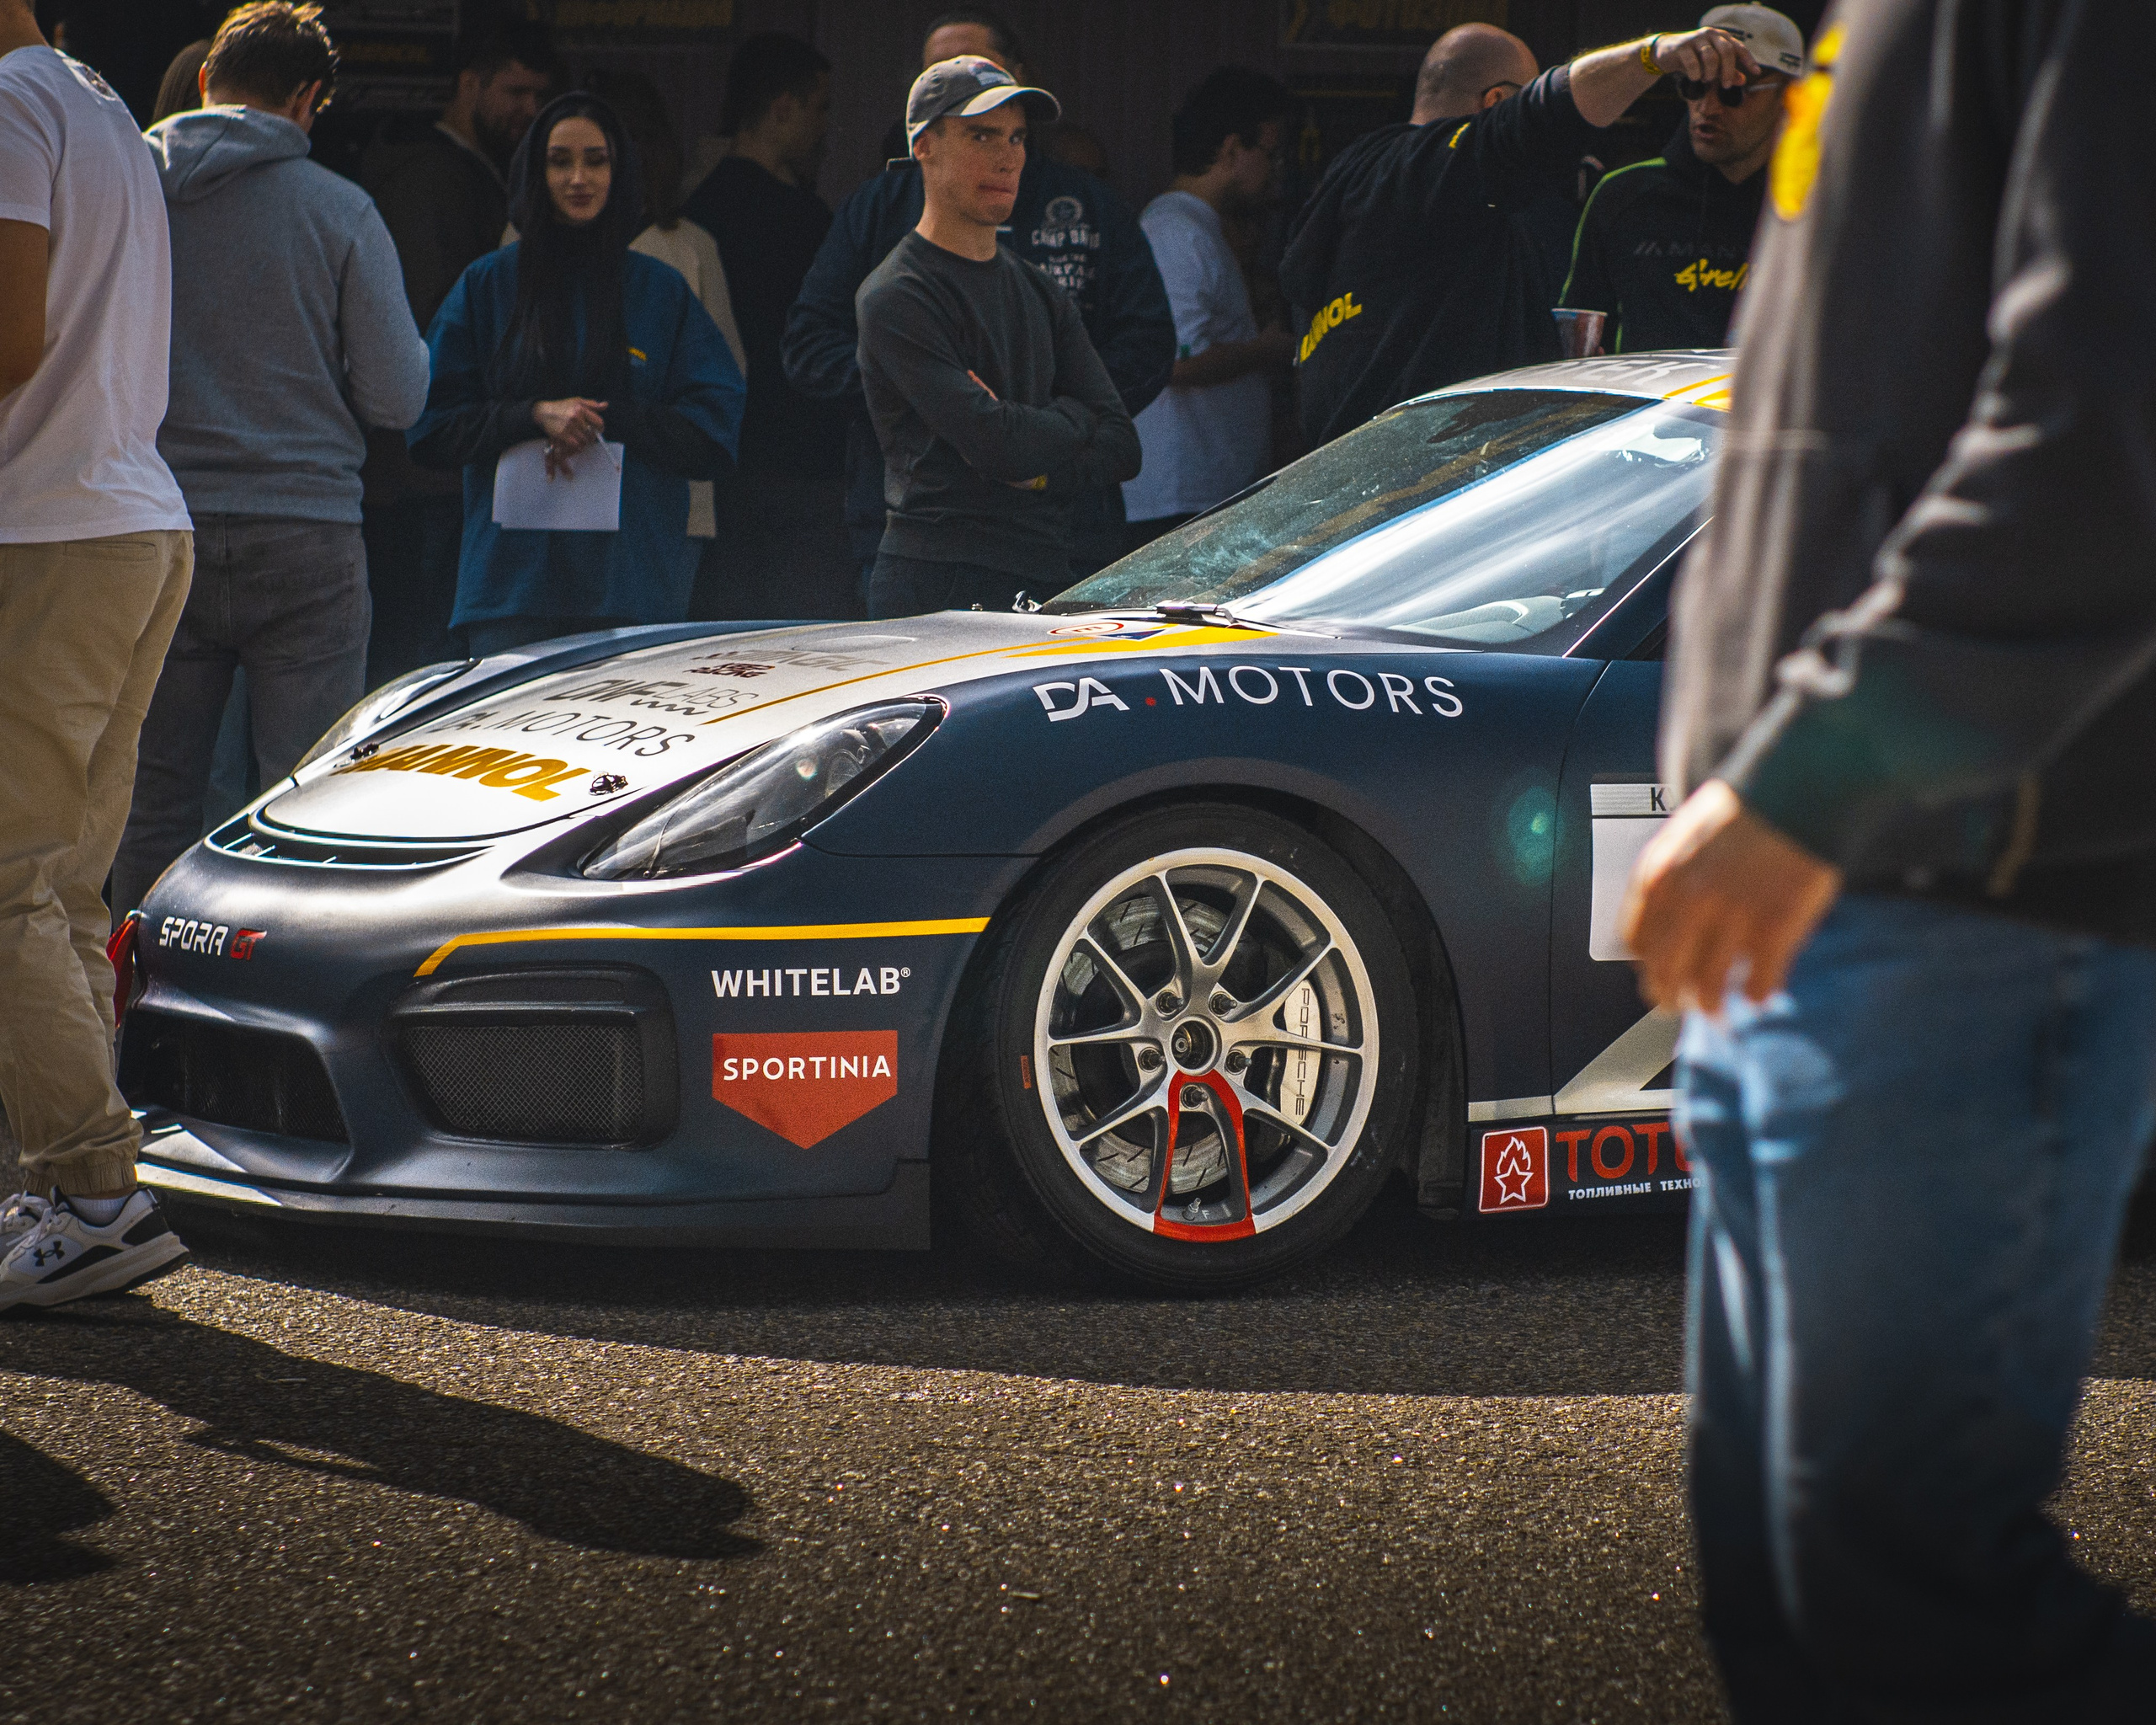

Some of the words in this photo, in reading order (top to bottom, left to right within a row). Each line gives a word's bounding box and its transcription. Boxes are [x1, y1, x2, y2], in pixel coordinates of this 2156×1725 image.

[1033, 677, 1130, 722] DA
[1159, 665, 1463, 718] MOTORS
[487, 710, 696, 757] MOTORS
[158, 916, 229, 957] SPORA
[230, 928, 268, 961] GT
[723, 1055, 892, 1081] SPORTINIA
[1295, 987, 1310, 1116] PORSCHE
[1568, 1182, 1652, 1200] ТОПЛИВНЫЕ
[1659, 1178, 1702, 1192] ТЕХНО
